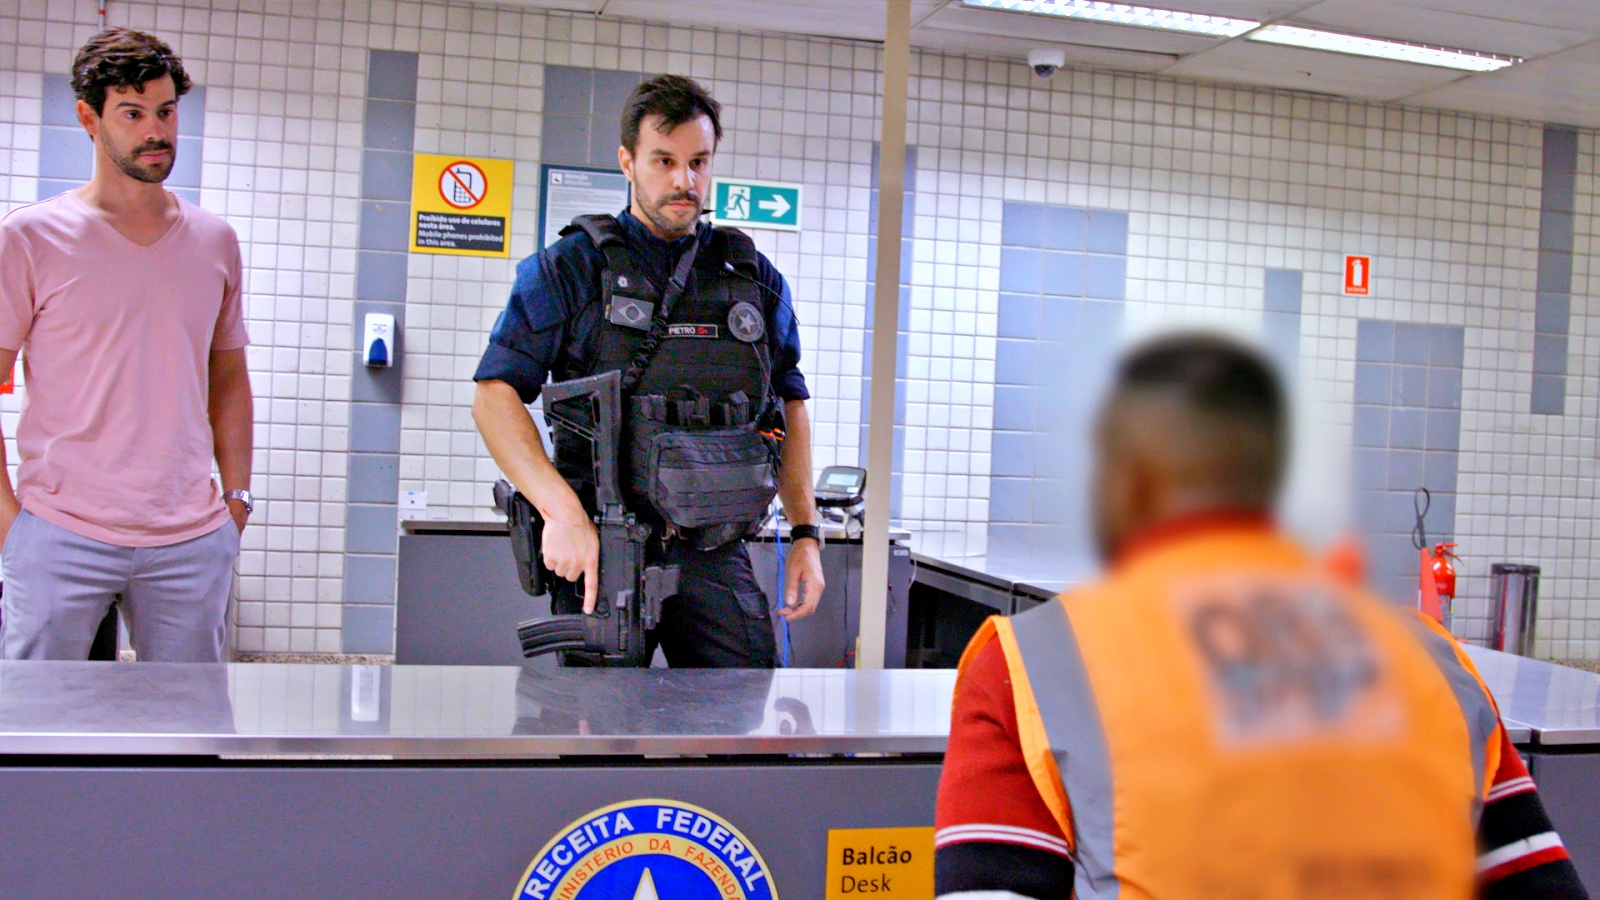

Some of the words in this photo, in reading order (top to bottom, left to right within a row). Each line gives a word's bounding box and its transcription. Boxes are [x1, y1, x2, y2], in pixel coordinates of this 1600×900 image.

[418, 214, 448, 223] Proibido
[470, 218, 501, 227] celulares
[418, 222, 438, 230] nesta
[418, 230, 442, 238] Mobile
[442, 231, 467, 240] phones
[468, 233, 503, 242] prohibited
[426, 238, 439, 246] this
[668, 326, 696, 335] PIETRO
[524, 812, 635, 900] RECEITA
[656, 807, 764, 892] FEDERAL
[842, 846, 912, 866] Balcão
[556, 841, 633, 900] INISTÉRIO
[649, 838, 672, 852] DA
[841, 873, 891, 893] Desk
